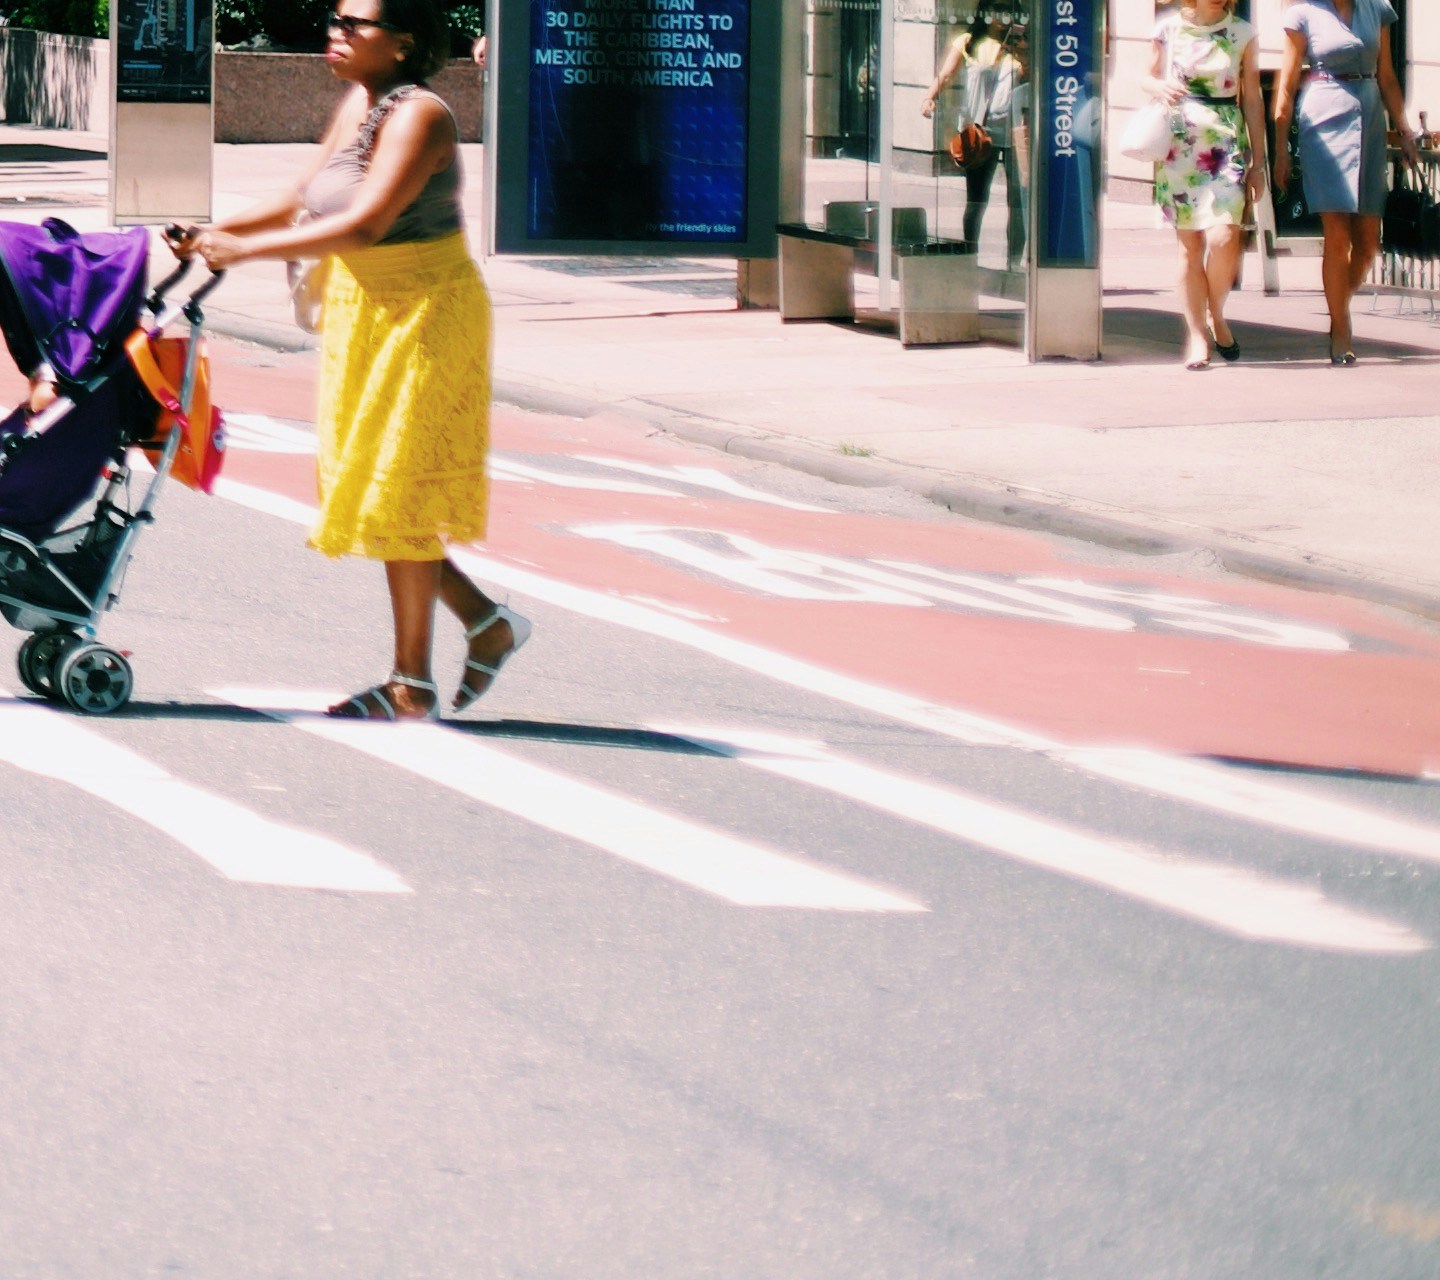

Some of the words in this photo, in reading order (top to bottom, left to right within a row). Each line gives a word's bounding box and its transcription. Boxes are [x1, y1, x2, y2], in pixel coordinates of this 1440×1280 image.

[545, 11, 569, 28] 30
[573, 11, 625, 28] DAILY
[631, 14, 705, 31] FLIGHTS
[708, 15, 733, 31] TO
[563, 30, 599, 47] THE
[605, 32, 715, 51] CARIBBEAN,
[1055, 33, 1079, 68] 50
[535, 48, 610, 68] MEXICO,
[615, 51, 698, 68] CENTRAL
[702, 52, 742, 69] AND
[563, 68, 624, 85] SOUTH
[631, 70, 714, 87] AMERICA
[1054, 75, 1079, 158] Street
[659, 223, 675, 232] the
[676, 223, 711, 234] friendly
[713, 223, 737, 233] skies
